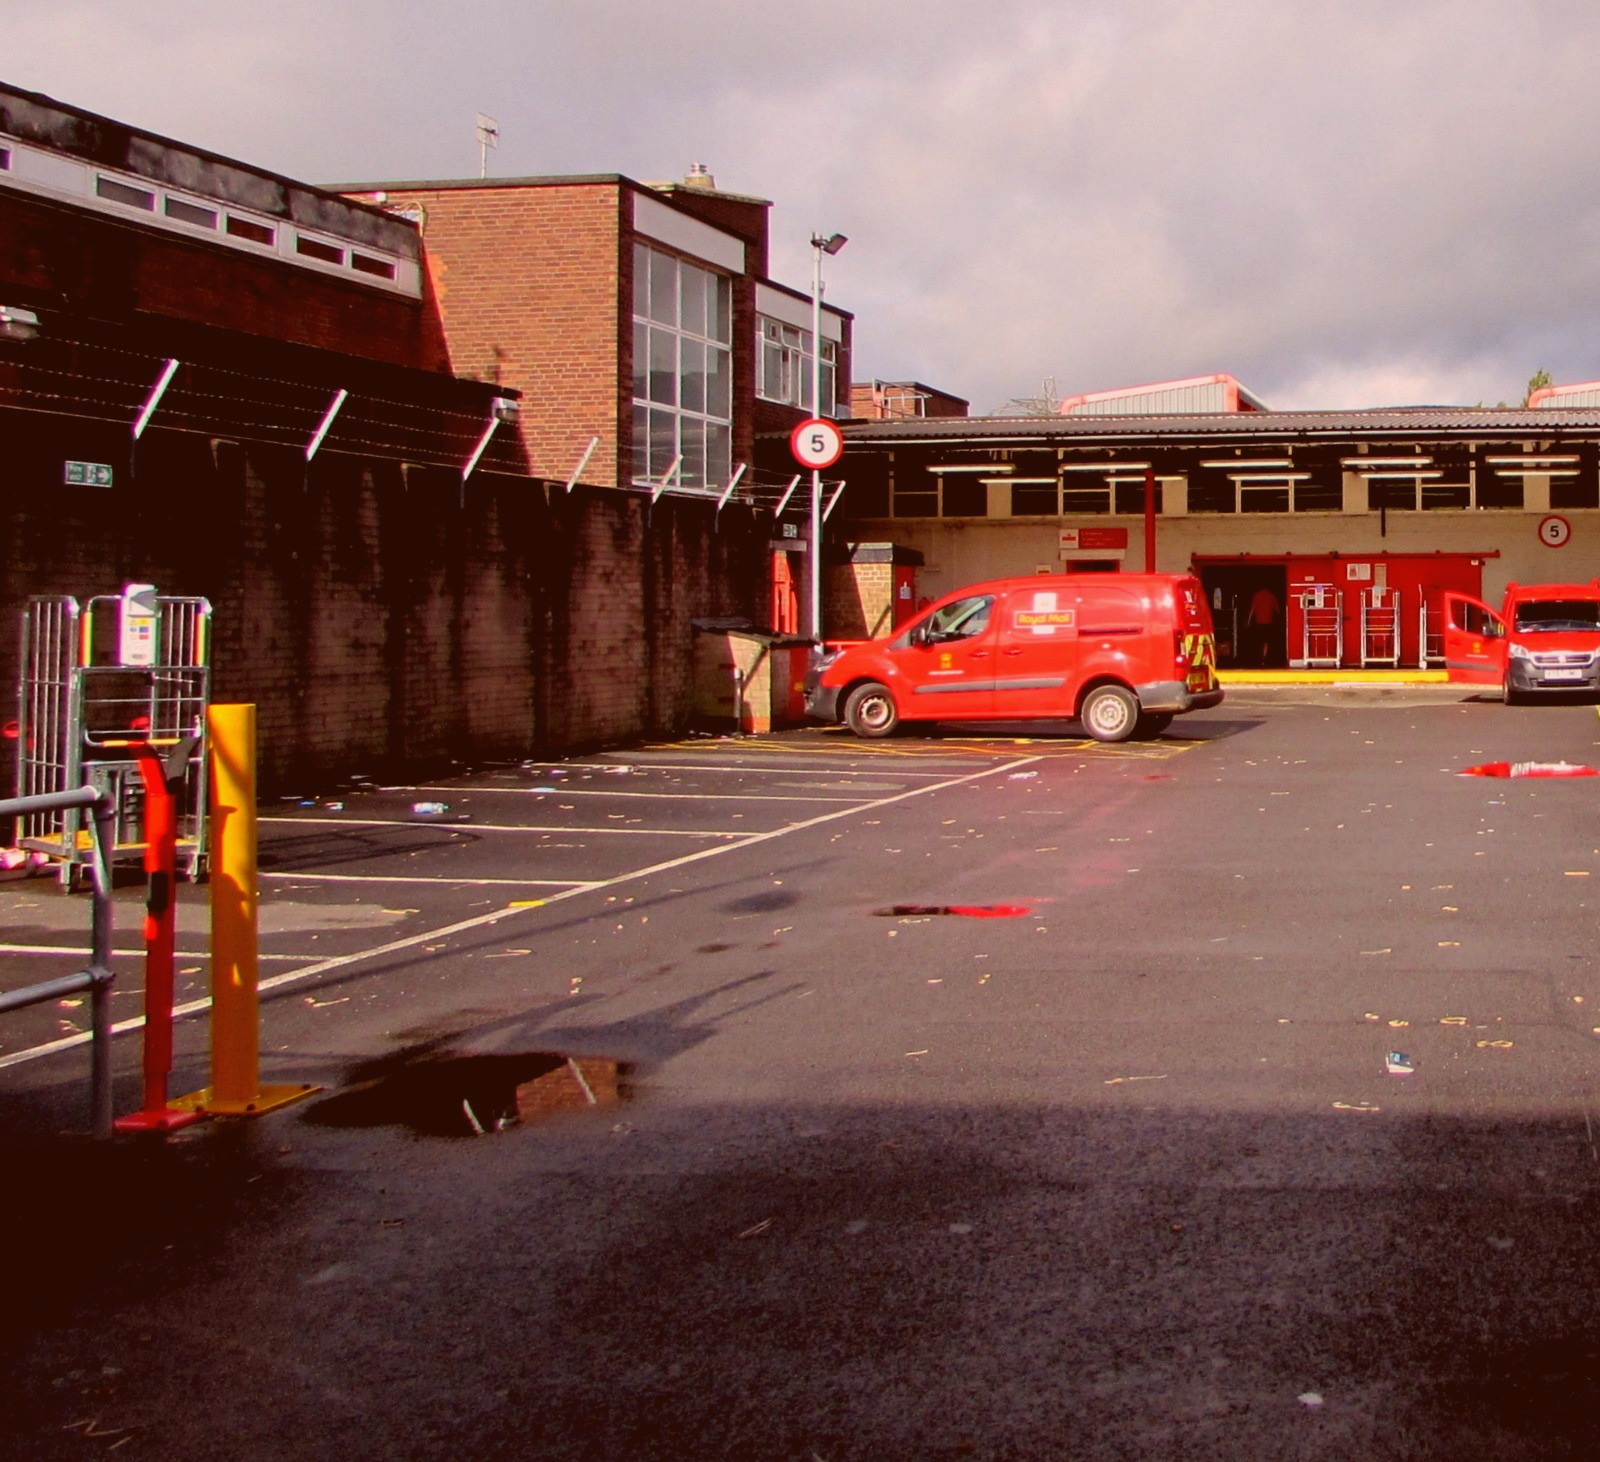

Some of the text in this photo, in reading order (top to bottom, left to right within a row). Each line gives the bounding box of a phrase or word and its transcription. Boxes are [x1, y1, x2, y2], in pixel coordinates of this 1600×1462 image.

[811, 434, 825, 453] 5
[1550, 525, 1559, 538] 5
[1018, 612, 1070, 625] Royal Mail
